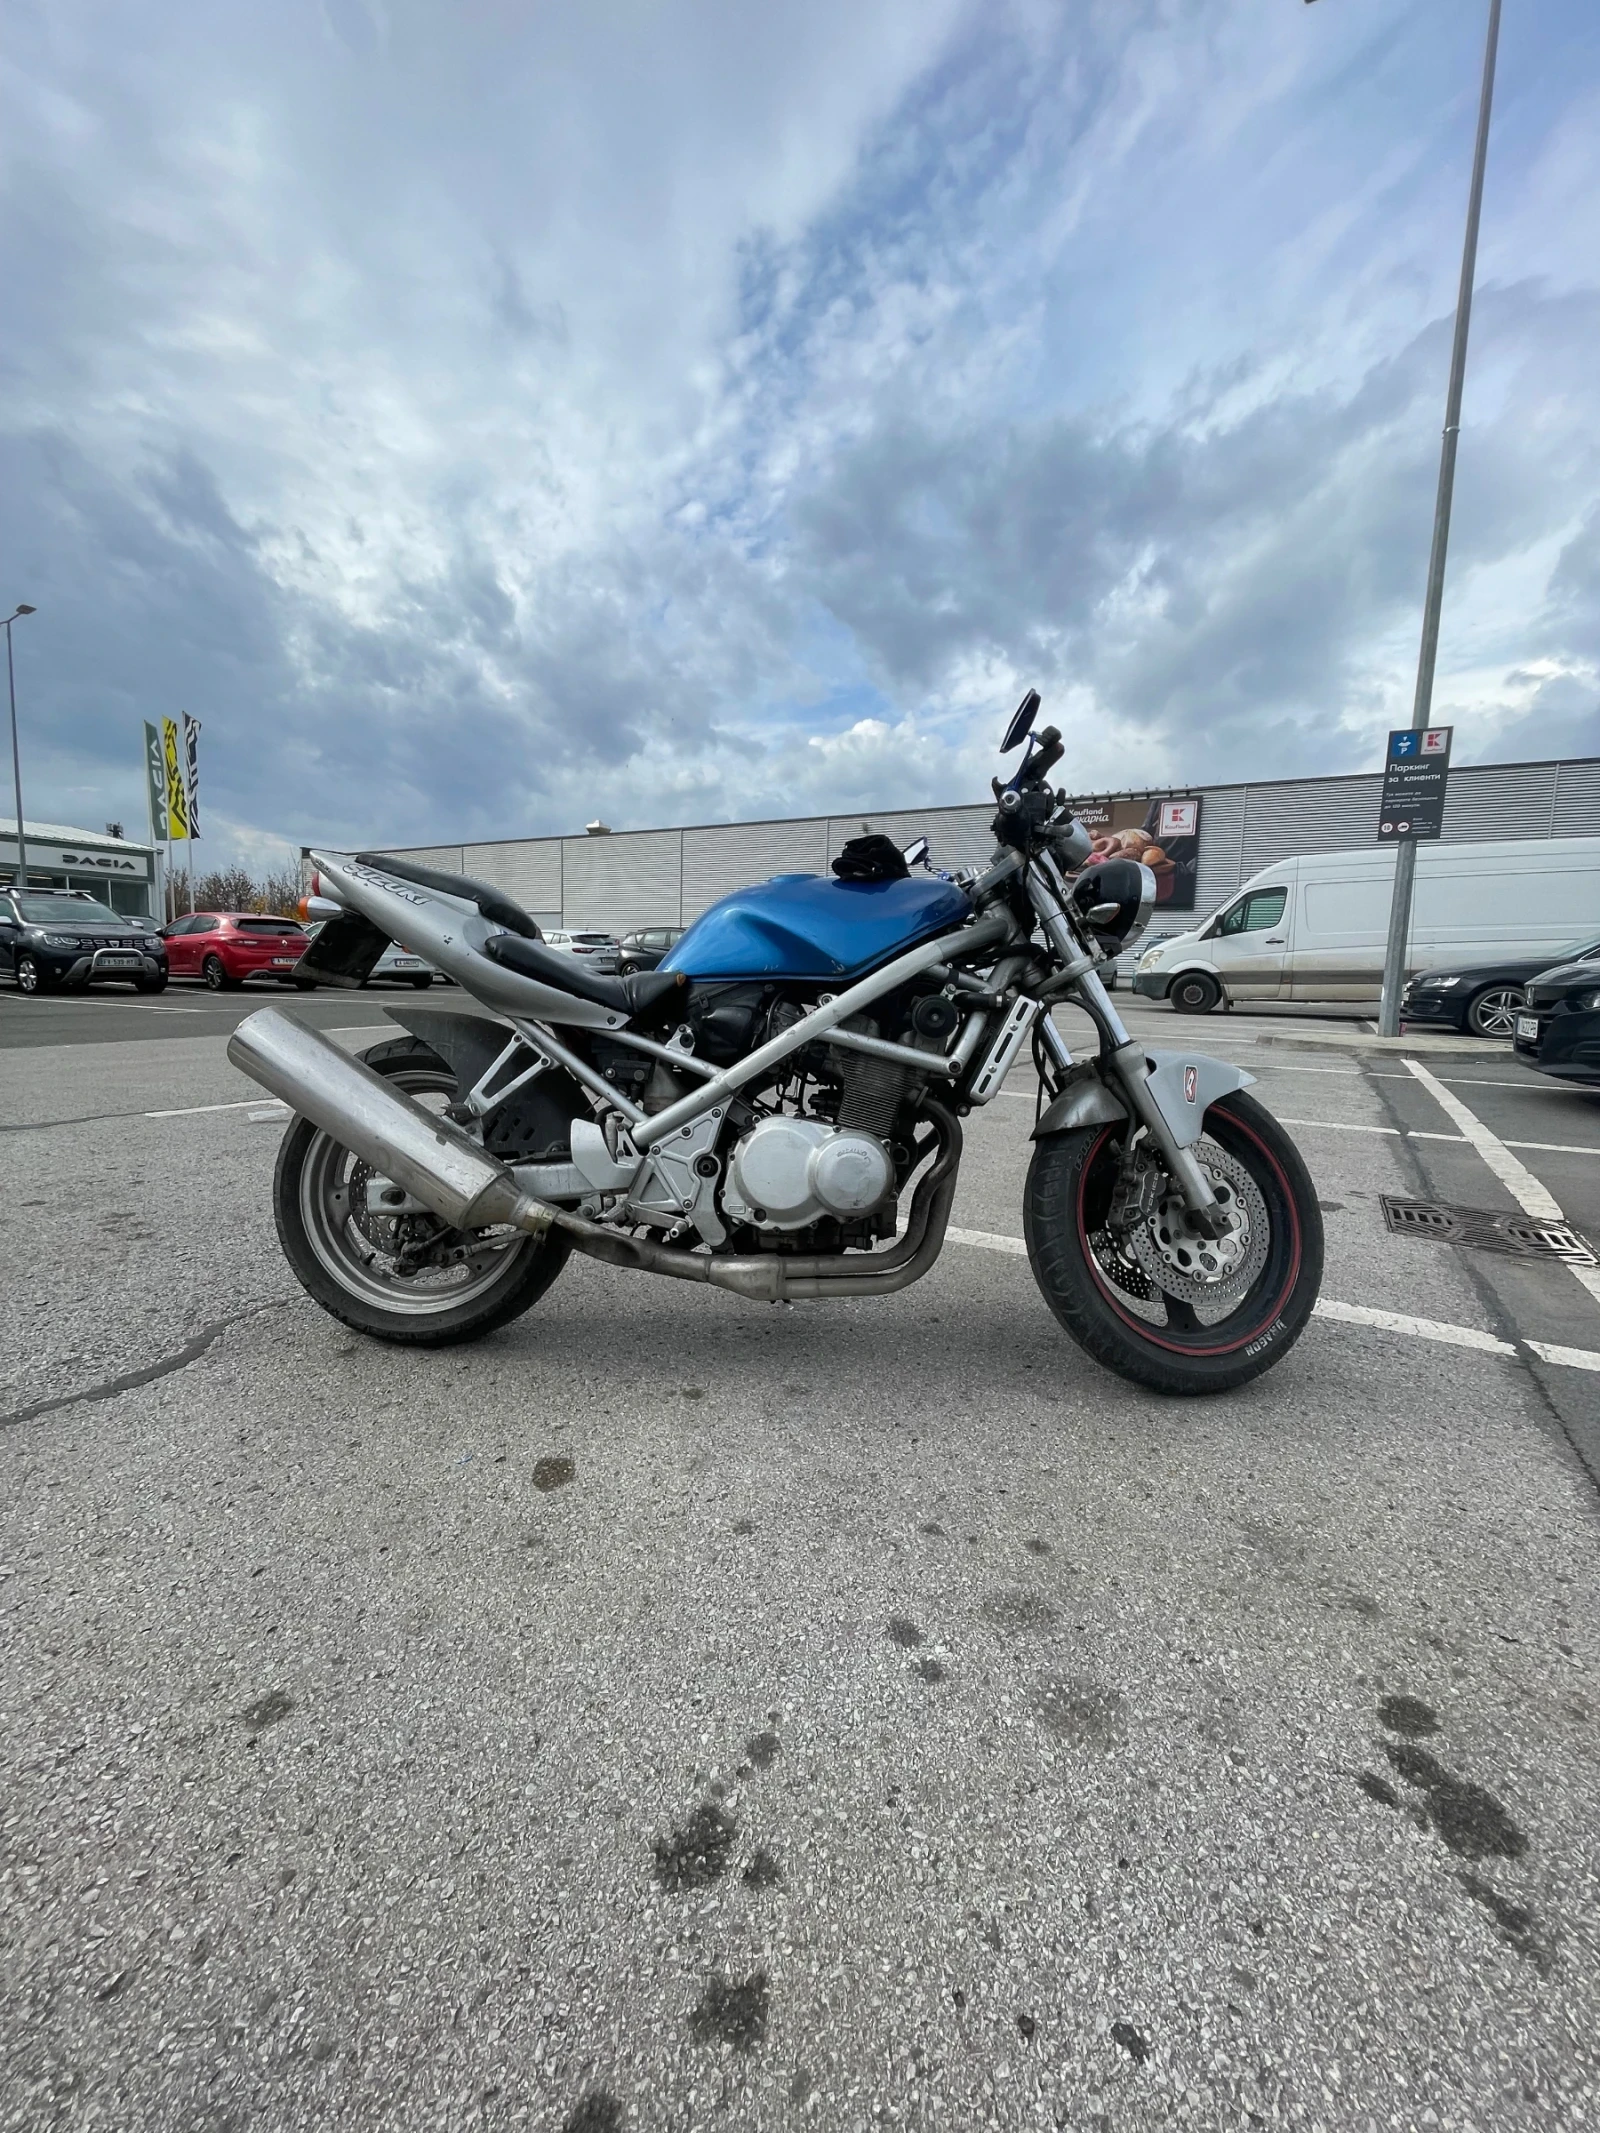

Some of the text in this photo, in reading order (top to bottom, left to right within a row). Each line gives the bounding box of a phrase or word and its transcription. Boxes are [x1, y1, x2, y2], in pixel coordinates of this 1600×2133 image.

[1400, 747, 1408, 755] P
[1389, 763, 1431, 773] Паркинг
[1403, 773, 1441, 782] клиенти
[62, 854, 136, 870] DACIA
[342, 863, 433, 906] SUZUKI
[1146, 1172, 1160, 1213] TOKICO
[1244, 1318, 1288, 1357] DRAGON
